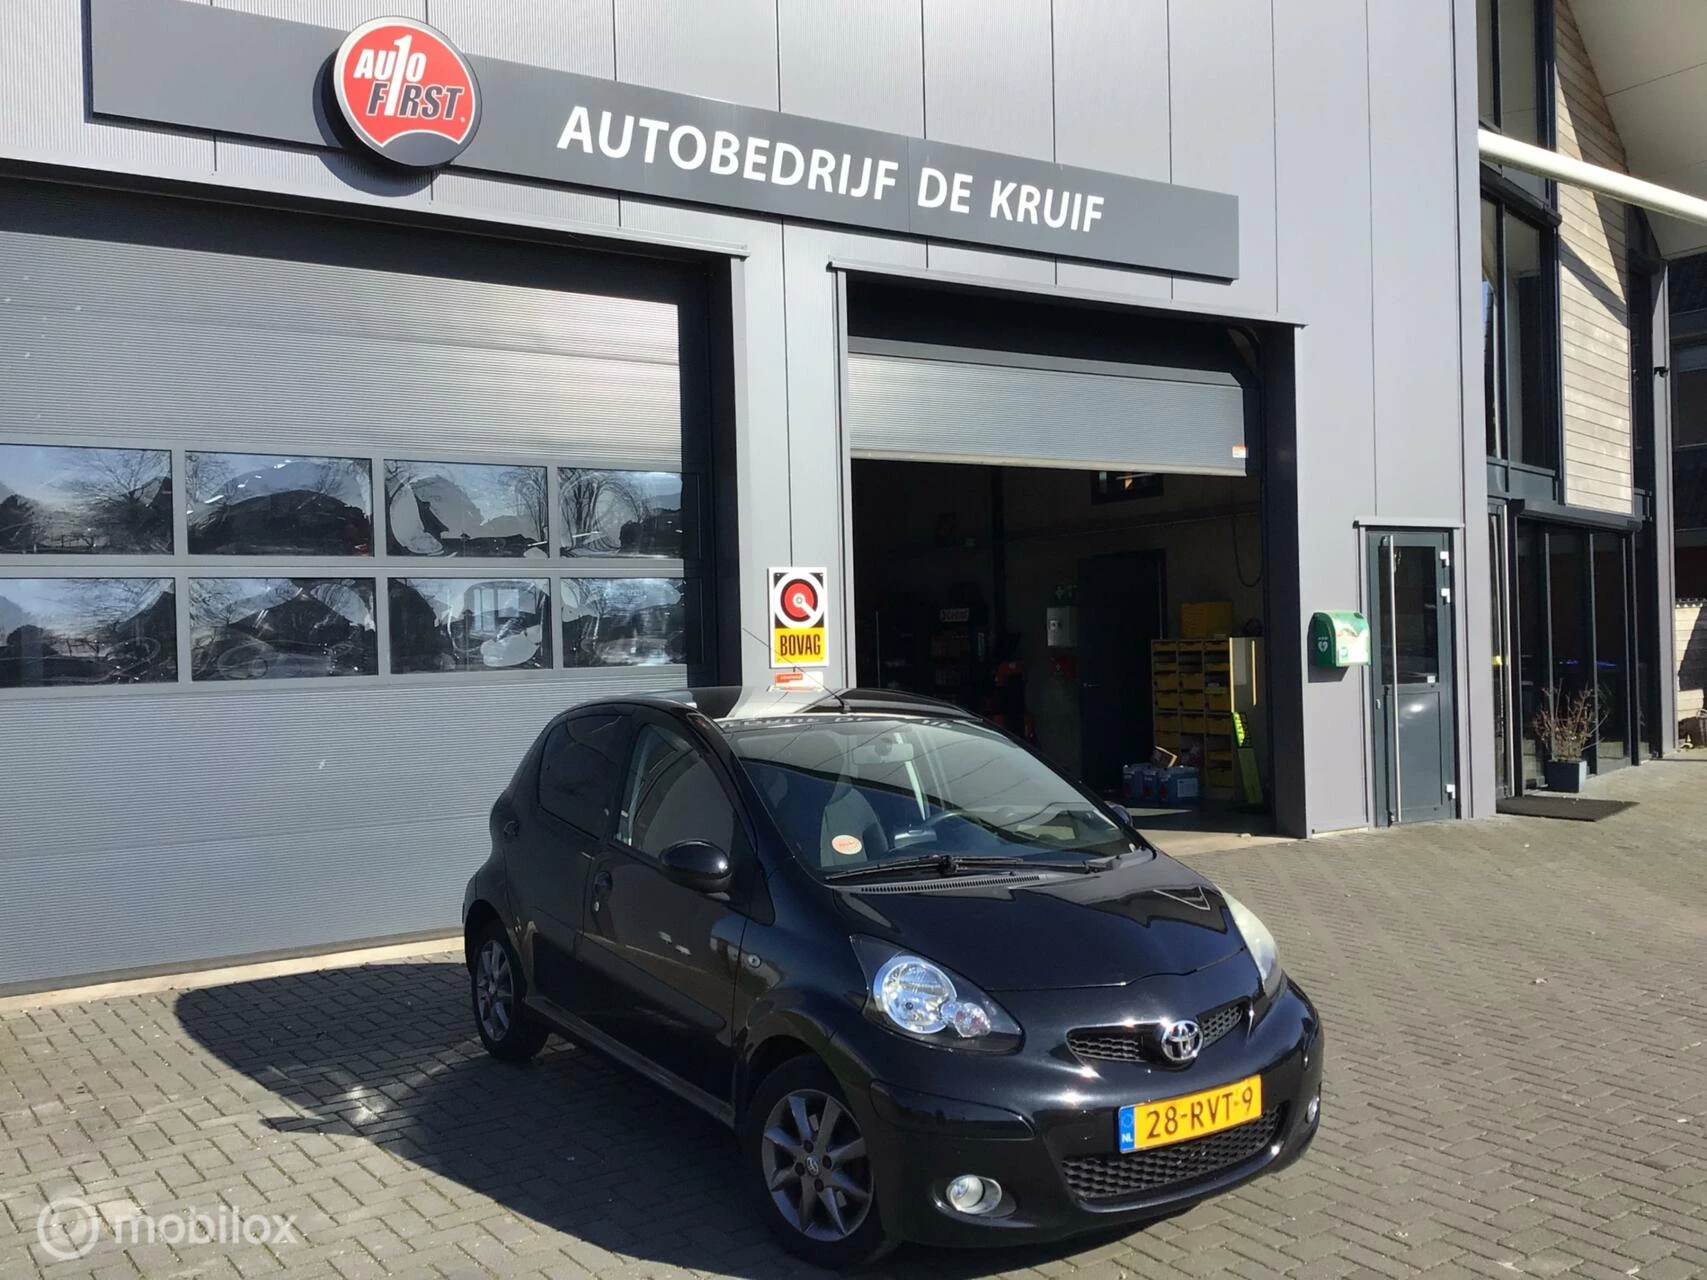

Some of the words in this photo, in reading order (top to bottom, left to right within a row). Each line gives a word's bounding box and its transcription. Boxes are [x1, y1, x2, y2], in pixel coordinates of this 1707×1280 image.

[556, 105, 899, 202] AUTOBEDRIJF
[917, 166, 974, 215] DE
[990, 180, 1105, 233] KRUIF
[780, 633, 821, 657] BOVAG
[1145, 1086, 1253, 1140] 28-RVT-9
[1121, 1132, 1134, 1143] NL
